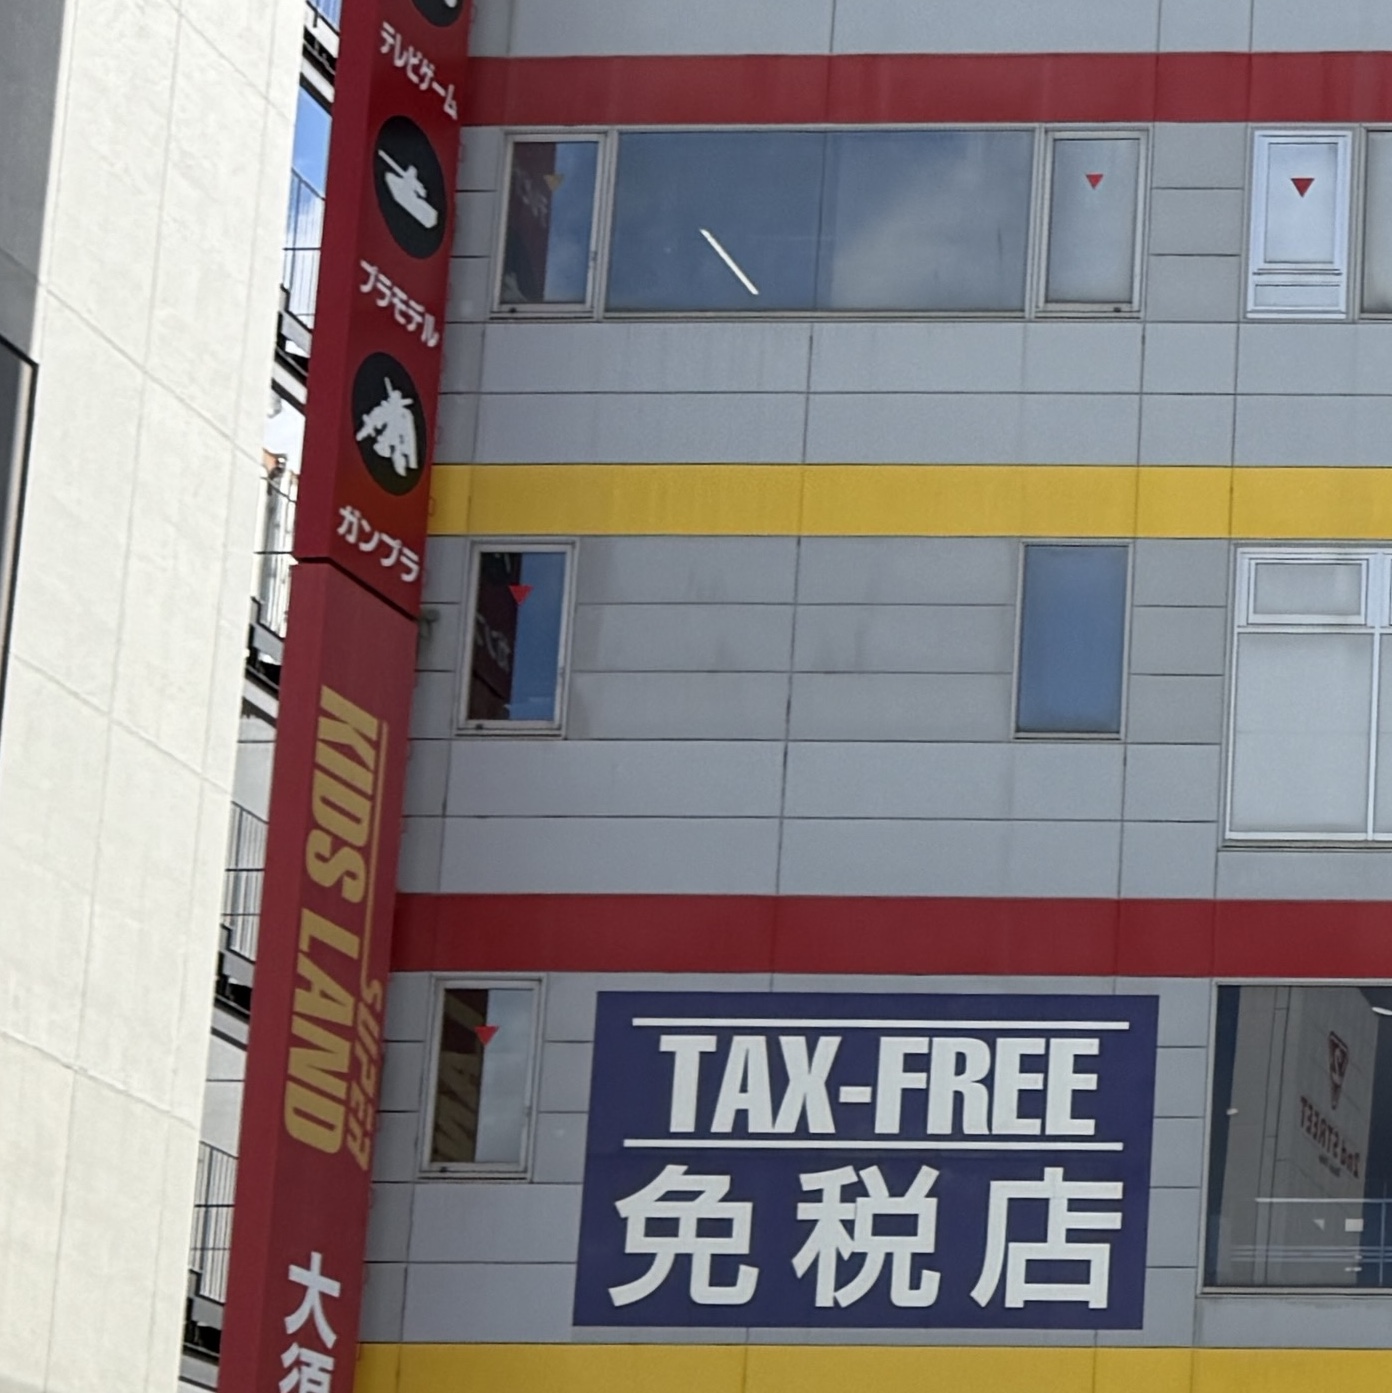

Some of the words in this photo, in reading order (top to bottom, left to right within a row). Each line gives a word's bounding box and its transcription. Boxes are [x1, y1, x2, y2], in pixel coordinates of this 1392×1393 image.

[380, 21, 458, 120] テレビゲーム
[360, 260, 440, 347] プラモデル
[337, 506, 419, 583] ガンプラ
[305, 685, 379, 903] KIDS
[284, 908, 360, 1154] LAND
[659, 1035, 1100, 1136] TAX-FREE
[608, 1165, 1124, 1308] 免税店
